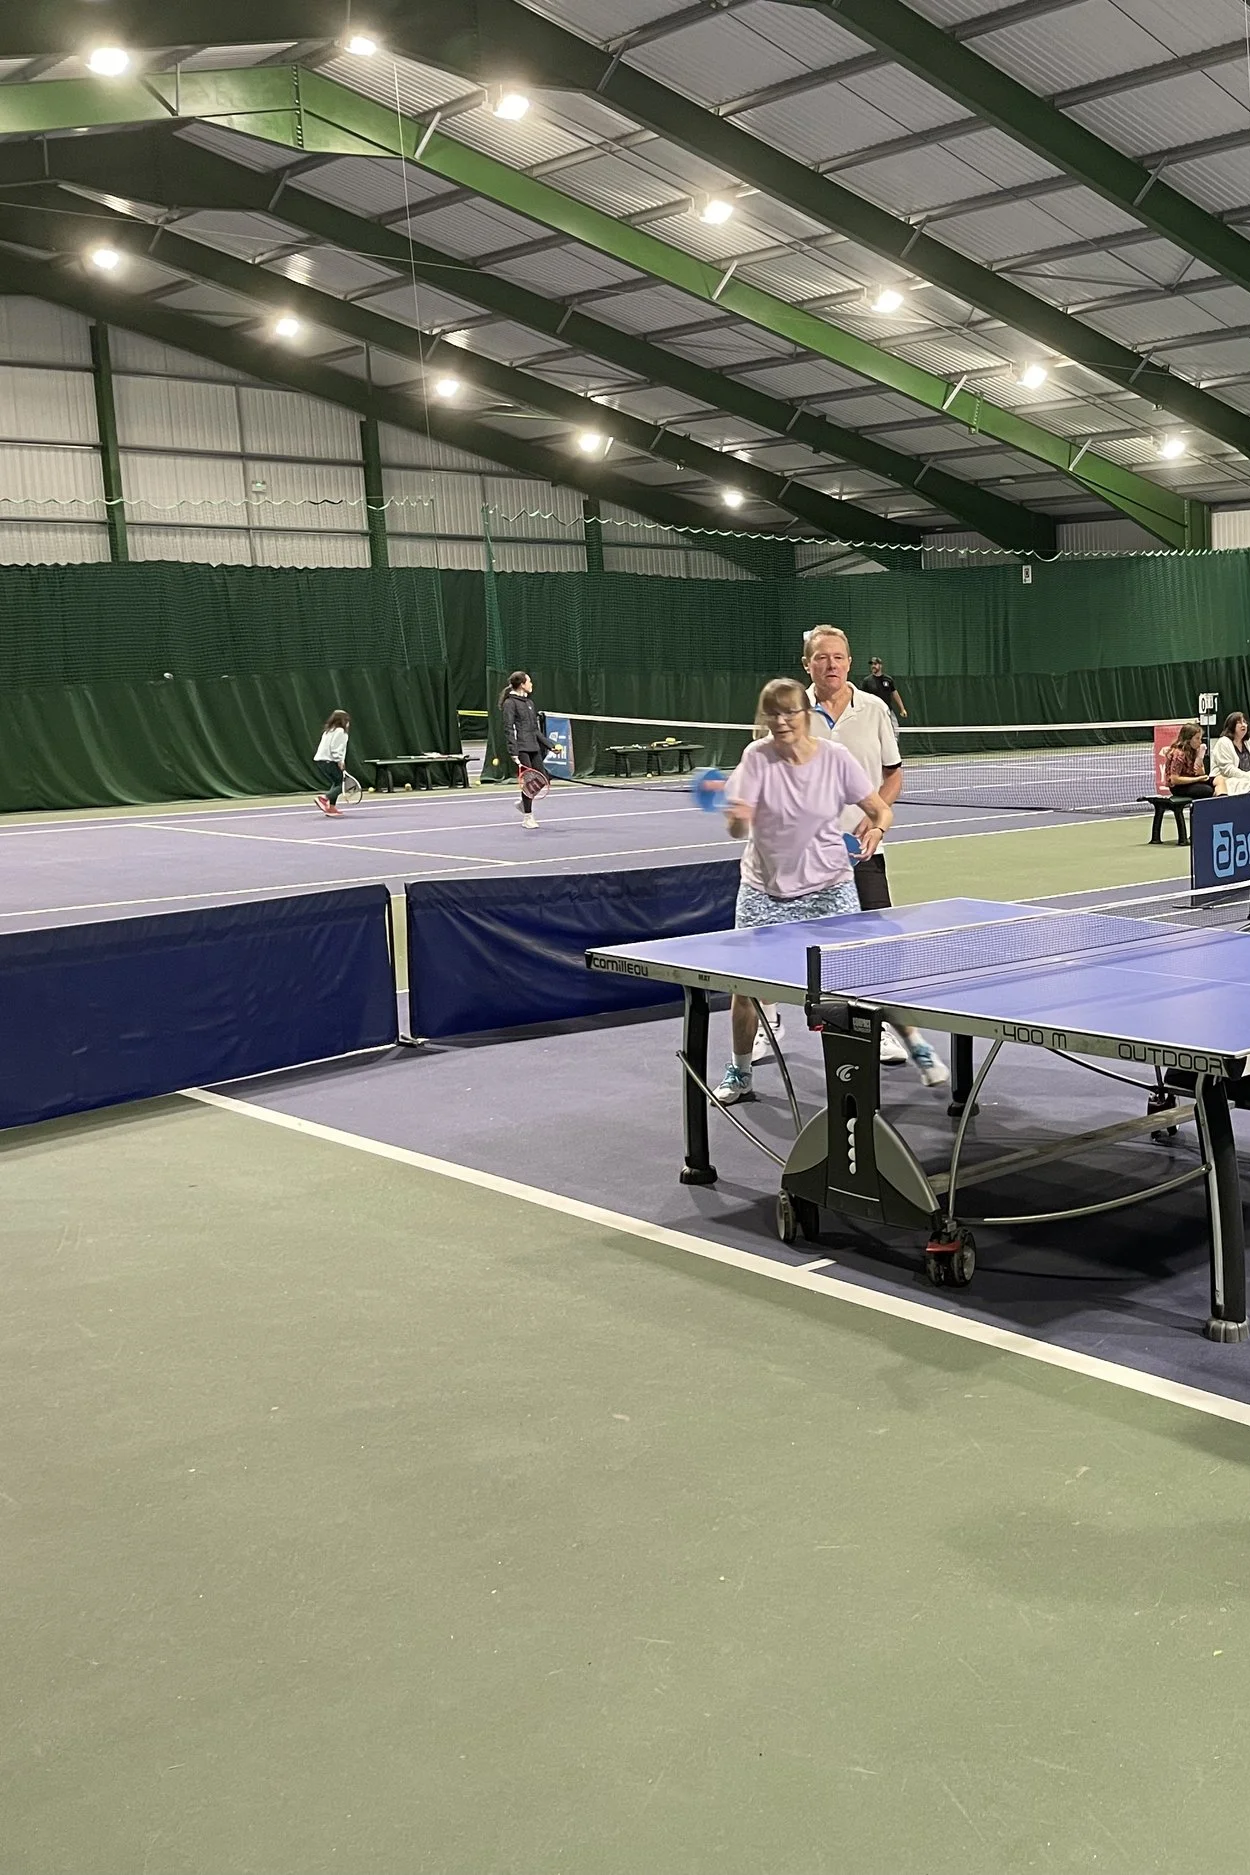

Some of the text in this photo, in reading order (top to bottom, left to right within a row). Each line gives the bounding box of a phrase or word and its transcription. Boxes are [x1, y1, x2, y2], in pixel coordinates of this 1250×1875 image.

[592, 956, 649, 977] cornilleau
[1002, 1024, 1044, 1045] 400
[1118, 1043, 1224, 1075] OUTDOOR
